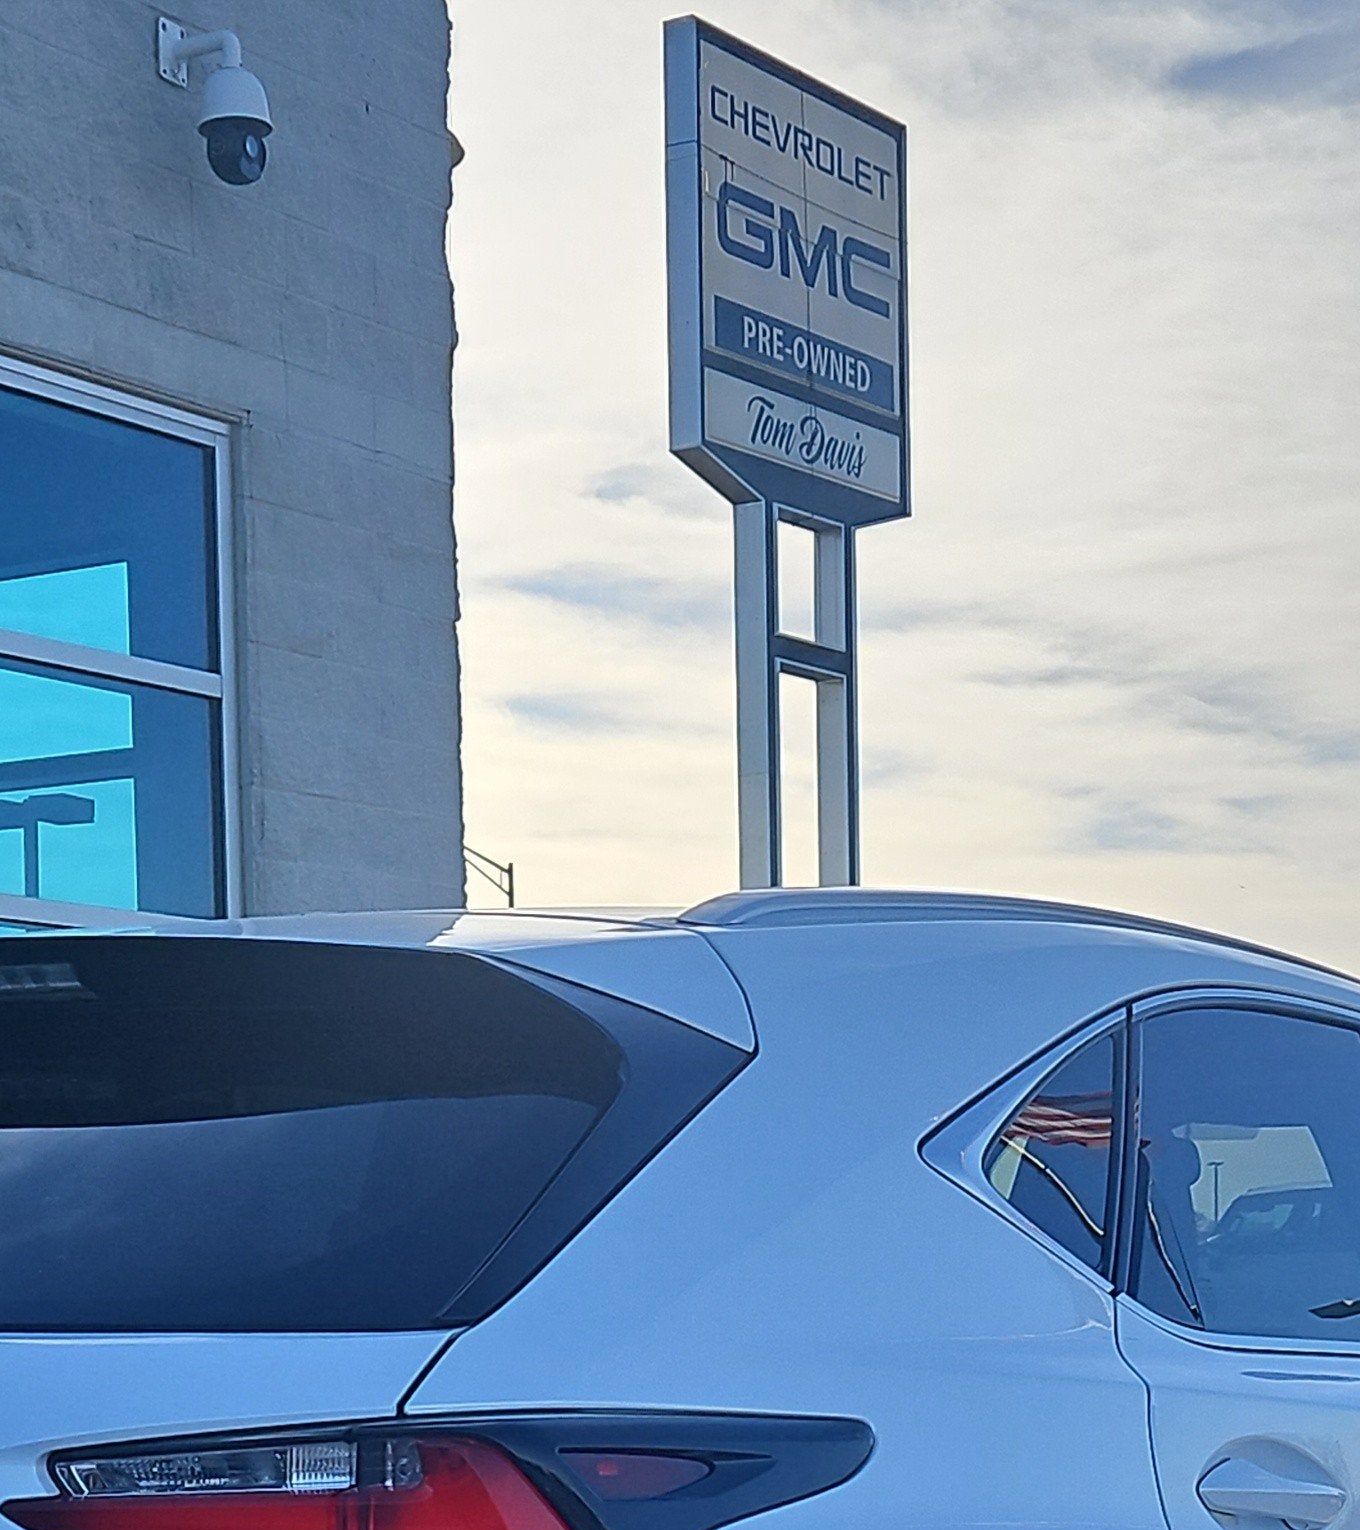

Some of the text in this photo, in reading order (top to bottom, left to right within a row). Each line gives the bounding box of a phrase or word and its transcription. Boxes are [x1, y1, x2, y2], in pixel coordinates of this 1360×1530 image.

[710, 85, 893, 200] CHEVROLET
[717, 181, 891, 319] GMC
[742, 315, 871, 393] PRE-OWNED
[746, 395, 868, 479] Tom Davis
